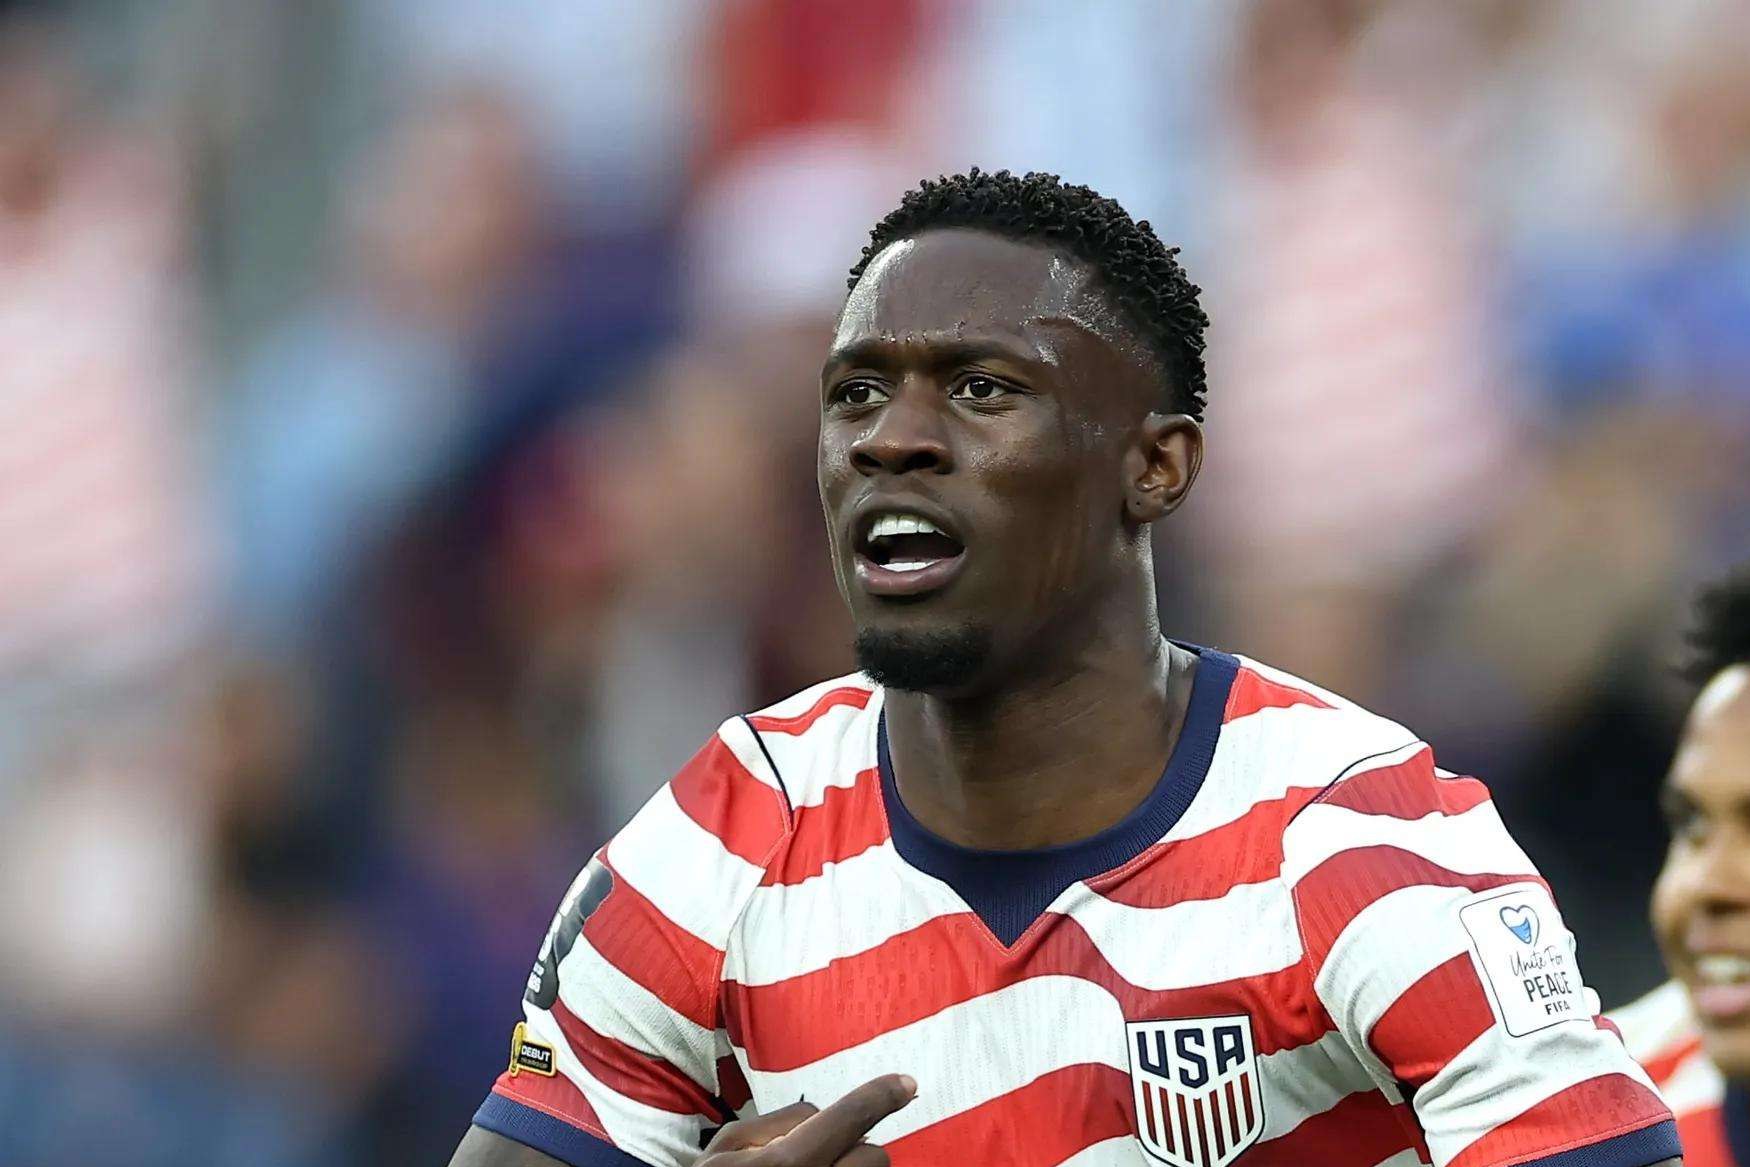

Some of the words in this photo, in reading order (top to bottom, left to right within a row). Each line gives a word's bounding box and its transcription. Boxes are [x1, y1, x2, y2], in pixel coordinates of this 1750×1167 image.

[1509, 951, 1546, 977] Unite
[1523, 971, 1572, 1002] PEACE
[1545, 1000, 1570, 1015] FIFA
[521, 1045, 551, 1062] DEBUT
[1136, 1025, 1246, 1089] USA
